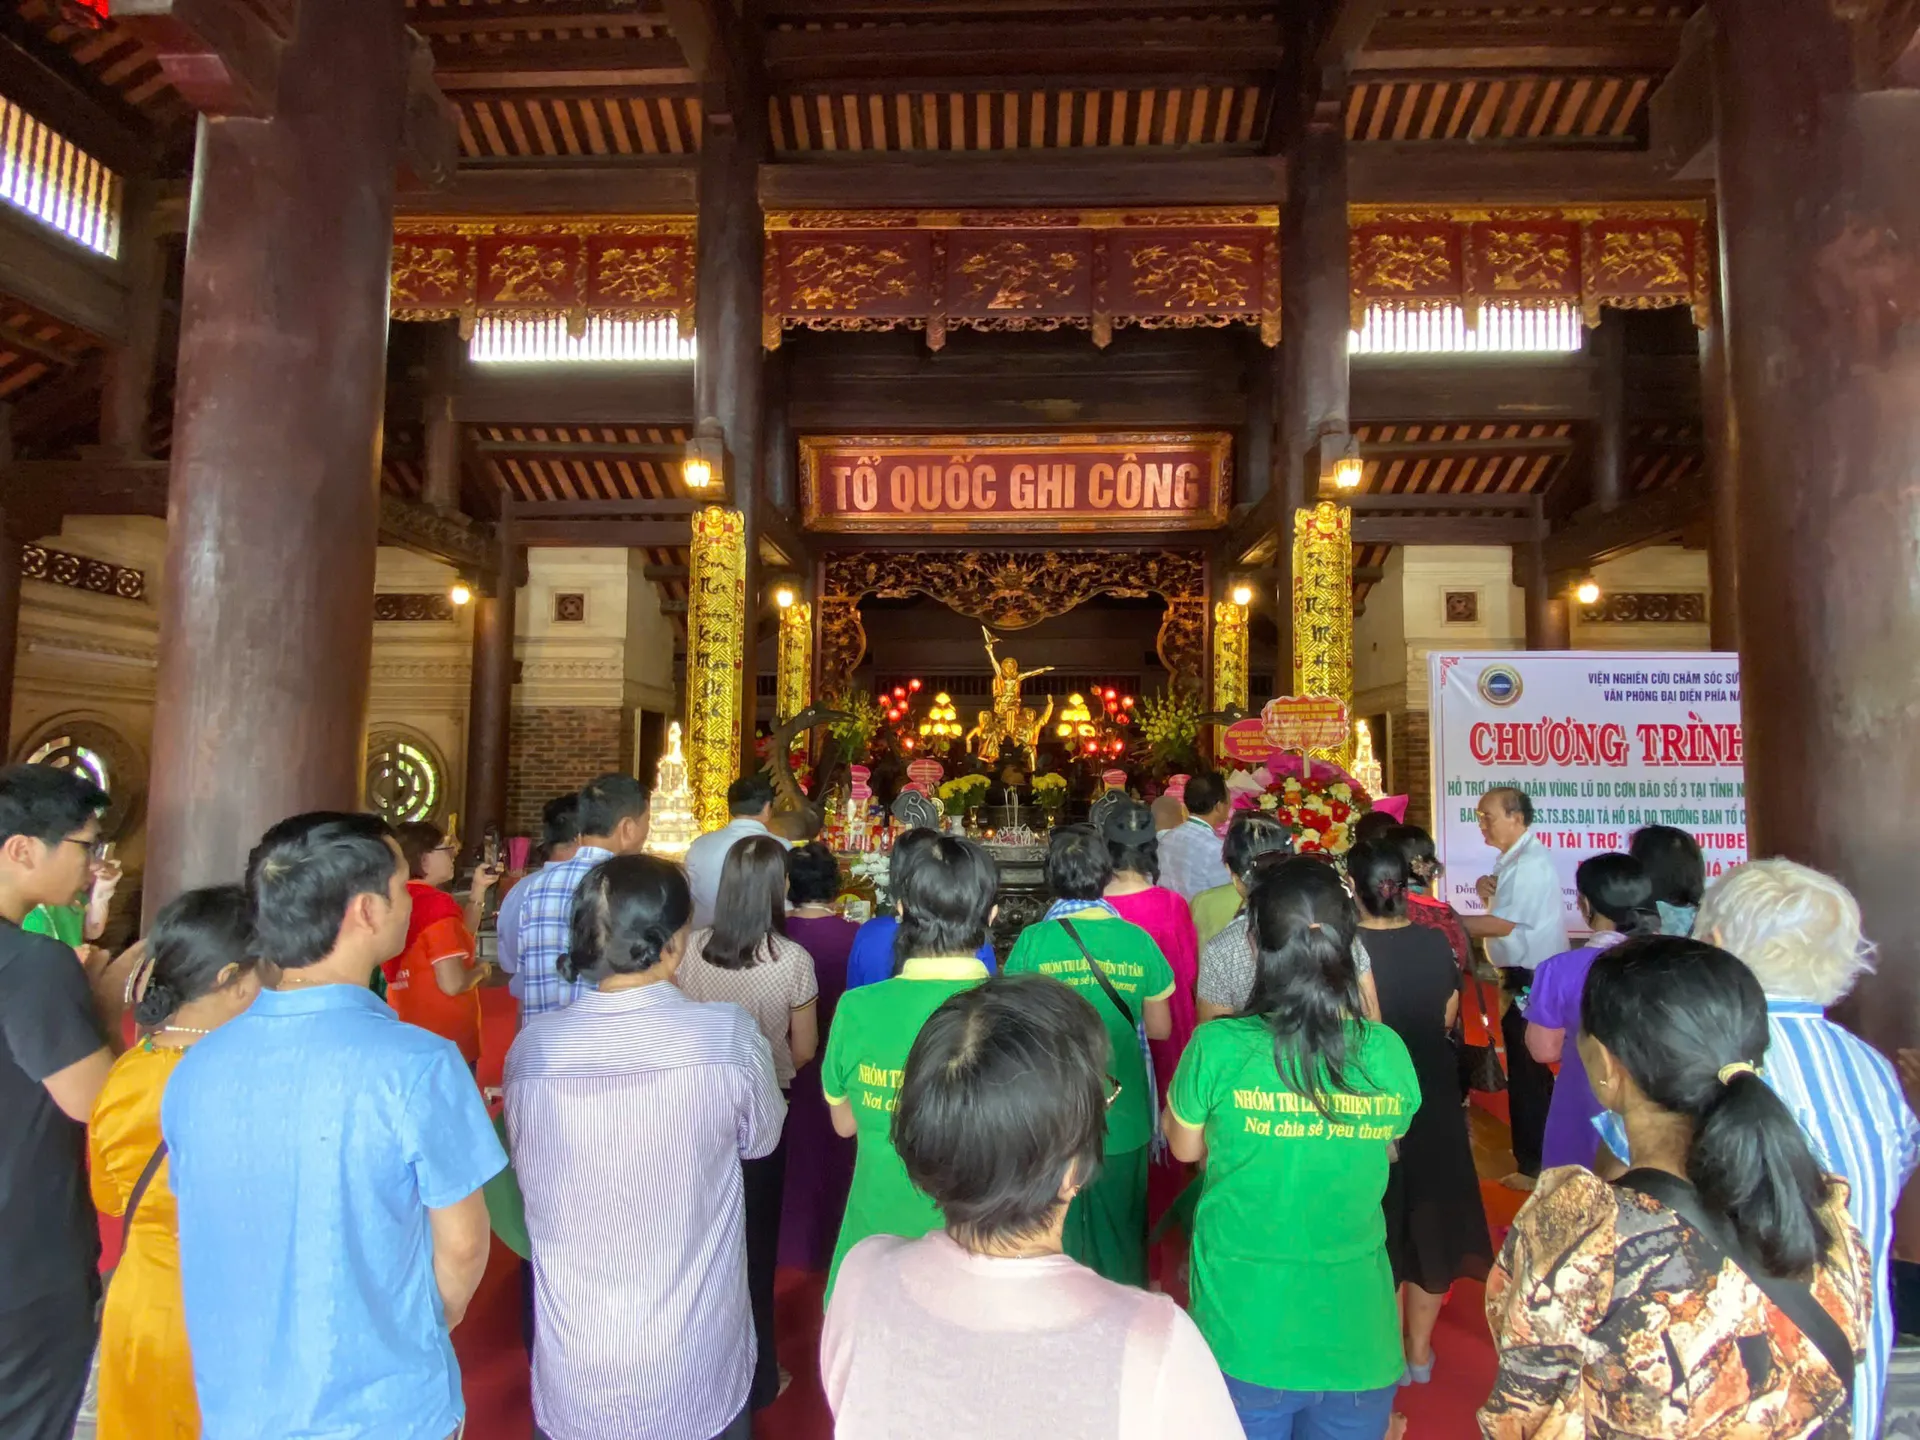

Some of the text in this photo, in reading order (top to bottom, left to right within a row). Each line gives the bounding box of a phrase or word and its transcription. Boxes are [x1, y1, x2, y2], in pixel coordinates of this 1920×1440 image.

[831, 452, 1200, 512] TỔ QUỐC GHI CÔNG
[1588, 670, 1610, 687] VIỆN
[1612, 670, 1649, 684] NGHIÊN
[1703, 670, 1723, 685] SÓC
[1625, 687, 1658, 701] PHÒNG
[1704, 688, 1727, 701] PHÍA
[1469, 710, 1744, 767] CHƯƠNG TRÌNH
[1524, 778, 1547, 797] DÂN
[1549, 778, 1578, 797] VÙNG
[1581, 779, 1594, 797] LŨ
[1597, 782, 1611, 797] DO
[1614, 781, 1636, 797] CƠN
[1639, 779, 1660, 797] BÃO
[1663, 776, 1678, 797] SỐ
[1681, 783, 1687, 797] 3
[1690, 783, 1706, 801] TẠI
[1702, 809, 1722, 824] BAN
[1557, 829, 1581, 848] TÀI
[1695, 832, 1746, 849] UTUBE
[858, 1063, 888, 1087] NHÓM
[862, 1090, 883, 1110] Nơi
[1233, 1086, 1275, 1112] NHÓM
[1274, 1121, 1304, 1138] chia
